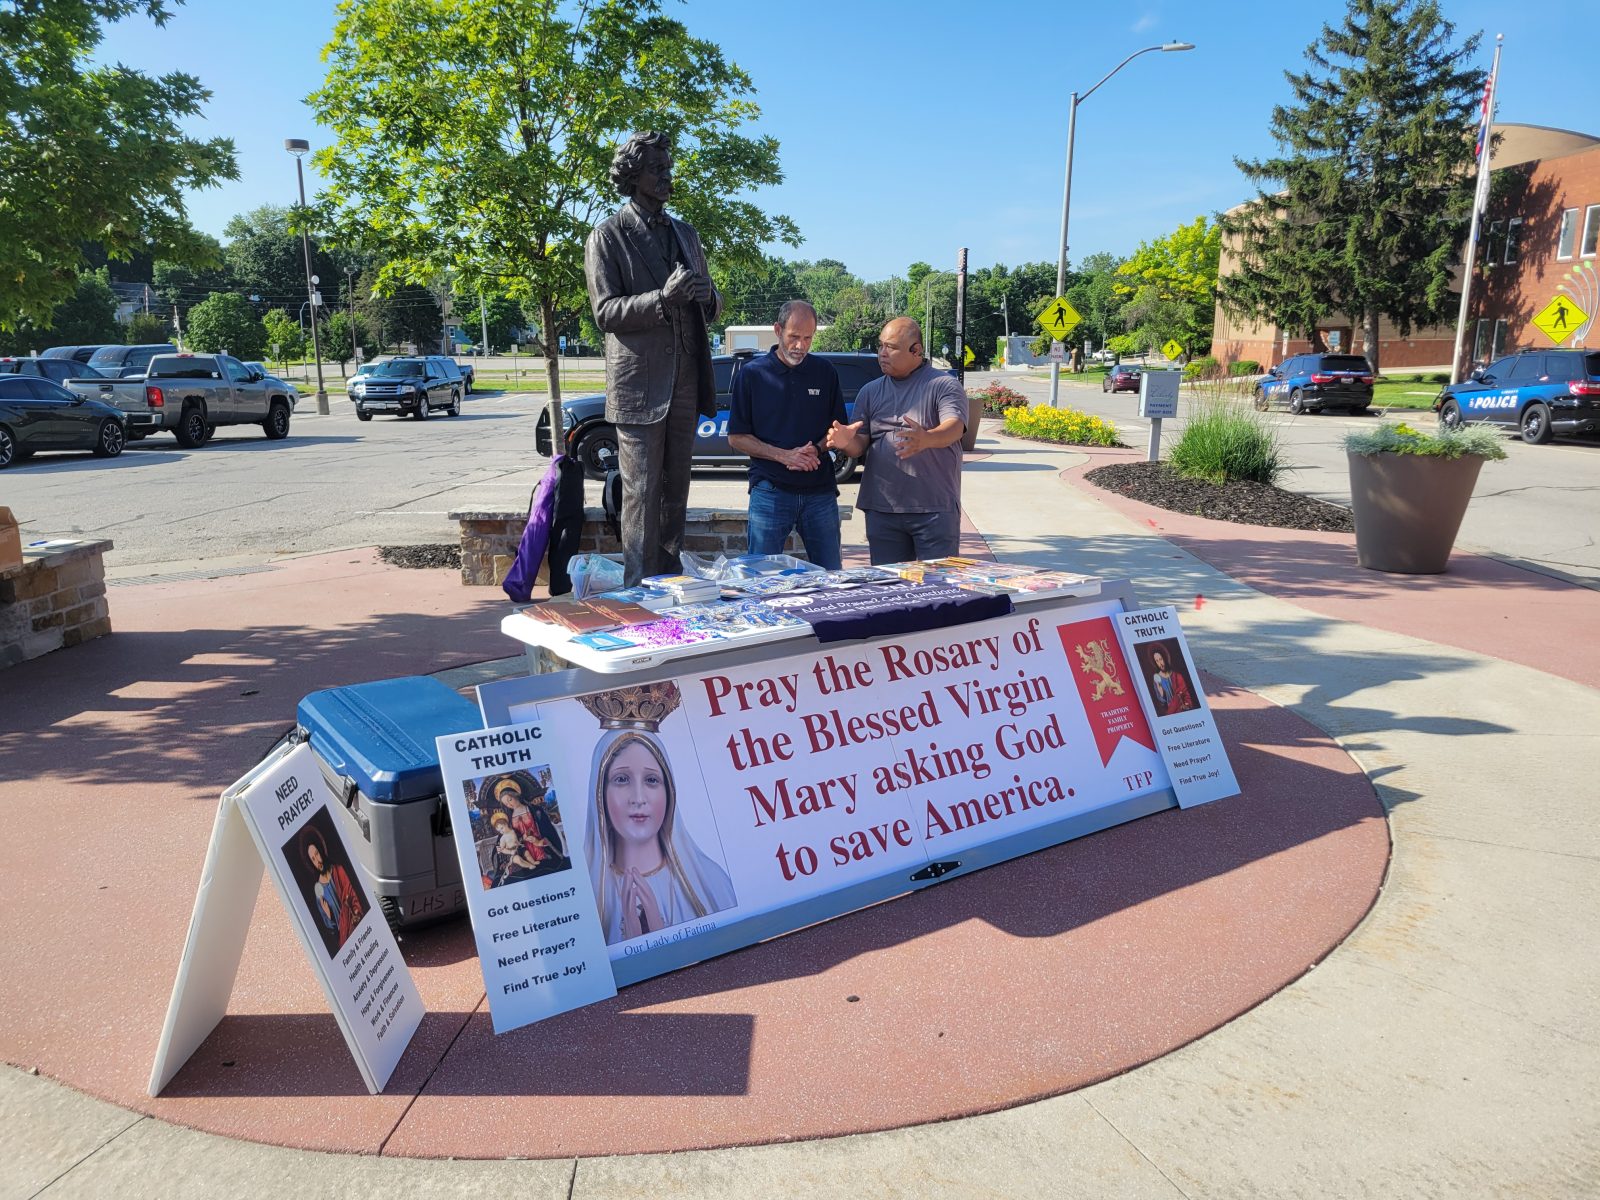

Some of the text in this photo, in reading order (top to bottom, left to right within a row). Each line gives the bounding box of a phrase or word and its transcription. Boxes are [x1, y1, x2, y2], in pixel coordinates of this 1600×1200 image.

[1474, 395, 1518, 409] POLICE
[1125, 611, 1169, 626] CATHOLIC
[1135, 626, 1165, 638] TRUTH
[700, 618, 1044, 718] Pray the Rosary of
[726, 670, 1055, 771] the Blessed Virgin
[1100, 706, 1129, 718] TRADITION
[1108, 715, 1128, 725] FAMILY
[455, 727, 542, 752] CATHOLIC
[1106, 722, 1134, 734] PROPERTY
[1162, 721, 1205, 736] Got Questions?
[471, 748, 531, 769] TRUTH
[1167, 738, 1211, 752] Free Literature
[744, 713, 1067, 828] Mary asking God
[1174, 754, 1211, 769] Need Prayer?
[275, 776, 298, 803] NEED
[1123, 770, 1153, 791] TFP
[1179, 769, 1220, 785] Find True Joy!
[278, 788, 314, 831] PRAYER?
[775, 775, 1075, 882] to save America.
[411, 895, 445, 915] LHS
[488, 887, 576, 918] Got Questions?
[493, 913, 580, 943] Free Literature
[624, 921, 716, 956] Our Lady of Fatima
[342, 925, 372, 968] Family & Friends
[348, 939, 379, 983] Health & Healing
[498, 937, 576, 968] Need Prayer?
[352, 980, 368, 1004] Anxiety
[369, 947, 389, 977] Depression
[361, 964, 395, 1017] Hope & Forgiveness
[503, 961, 586, 995] Find True Joy!
[370, 1010, 382, 1027] Work
[383, 981, 399, 1007] Finances
[376, 1023, 387, 1041] Faith
[388, 995, 405, 1021] Salvation
